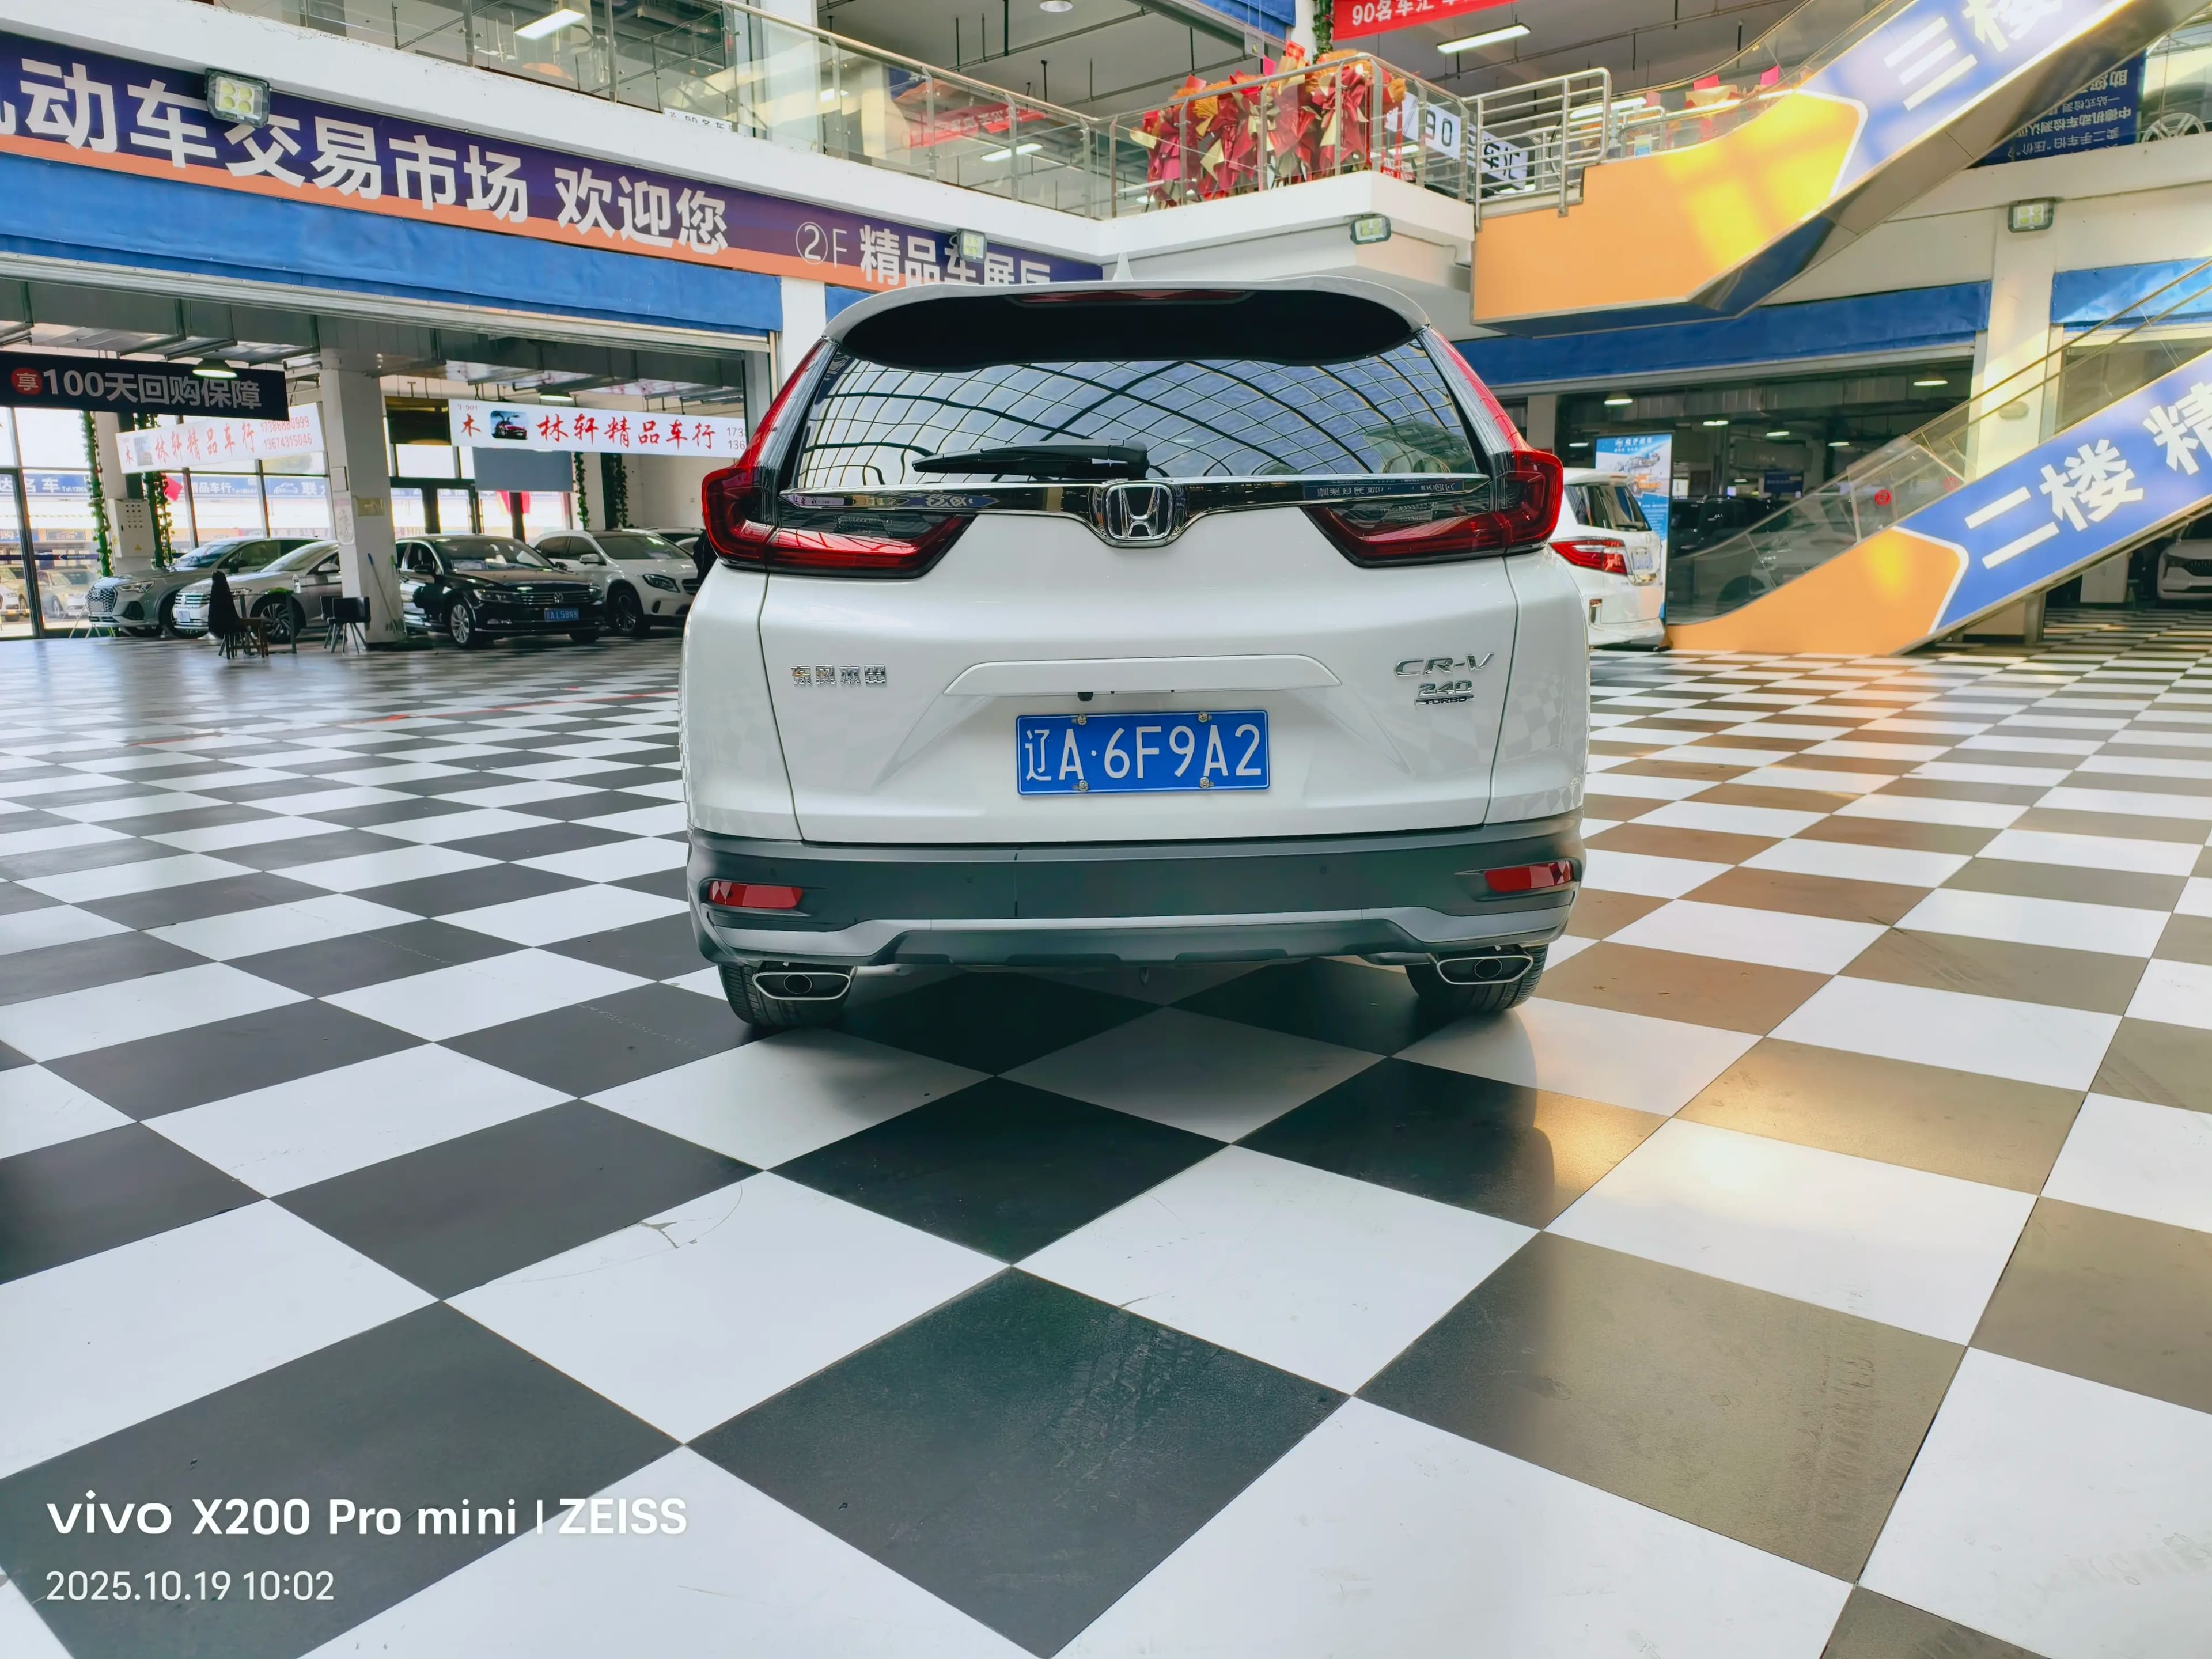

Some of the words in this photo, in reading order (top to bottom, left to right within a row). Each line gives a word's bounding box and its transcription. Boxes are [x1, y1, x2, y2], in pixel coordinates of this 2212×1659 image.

[0, 58, 528, 223] 动车交易市场
[554, 166, 729, 255] 欢迎您
[16, 372, 39, 392] 享
[43, 368, 262, 410] 100天回购保障
[154, 422, 255, 464] 林轩精品车行
[536, 413, 716, 451] 林轩精品车行
[1964, 439, 2144, 570] 二楼
[1393, 652, 1496, 677] CR-V
[1418, 680, 1473, 698] 240
[1422, 695, 1469, 706] TURBO
